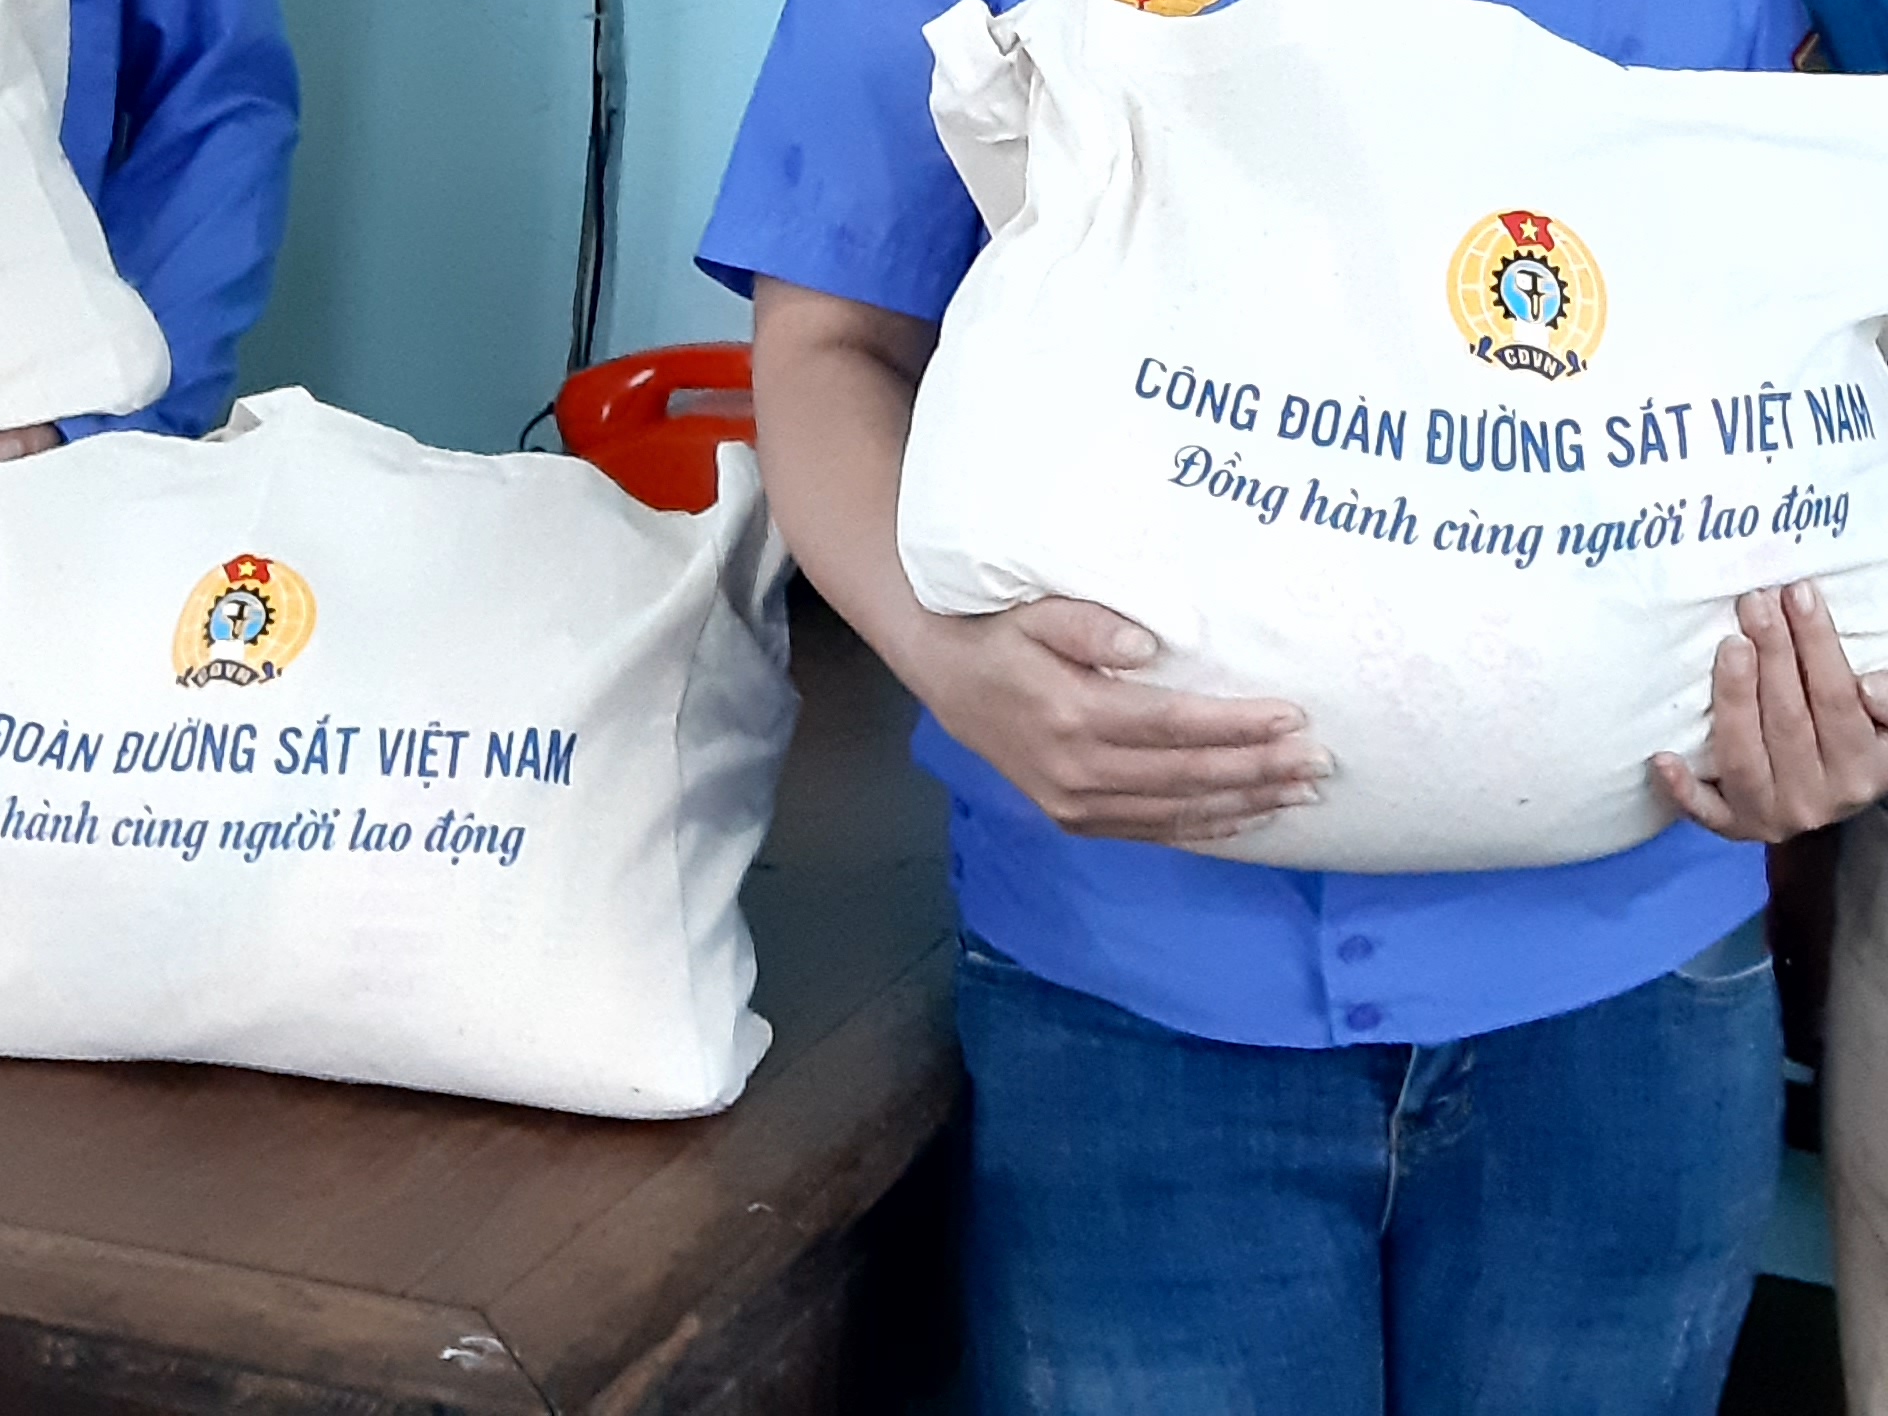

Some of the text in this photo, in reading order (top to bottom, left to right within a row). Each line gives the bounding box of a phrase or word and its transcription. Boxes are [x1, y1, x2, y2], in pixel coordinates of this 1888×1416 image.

[1134, 354, 1876, 472] CÔNG ĐOÀN ĐƯỜNG SẮT VIỆT NAM
[1168, 444, 1851, 568] Đồng hành cùng người lao động
[113, 717, 255, 774] ĐƯỜNG
[274, 714, 359, 777] SẮT
[378, 720, 469, 788] VIỆT
[484, 728, 578, 786] NAM
[0, 795, 99, 845] hành
[111, 803, 208, 860] cùng
[219, 808, 341, 861] người
[350, 808, 411, 853] lao
[424, 808, 525, 866] động
